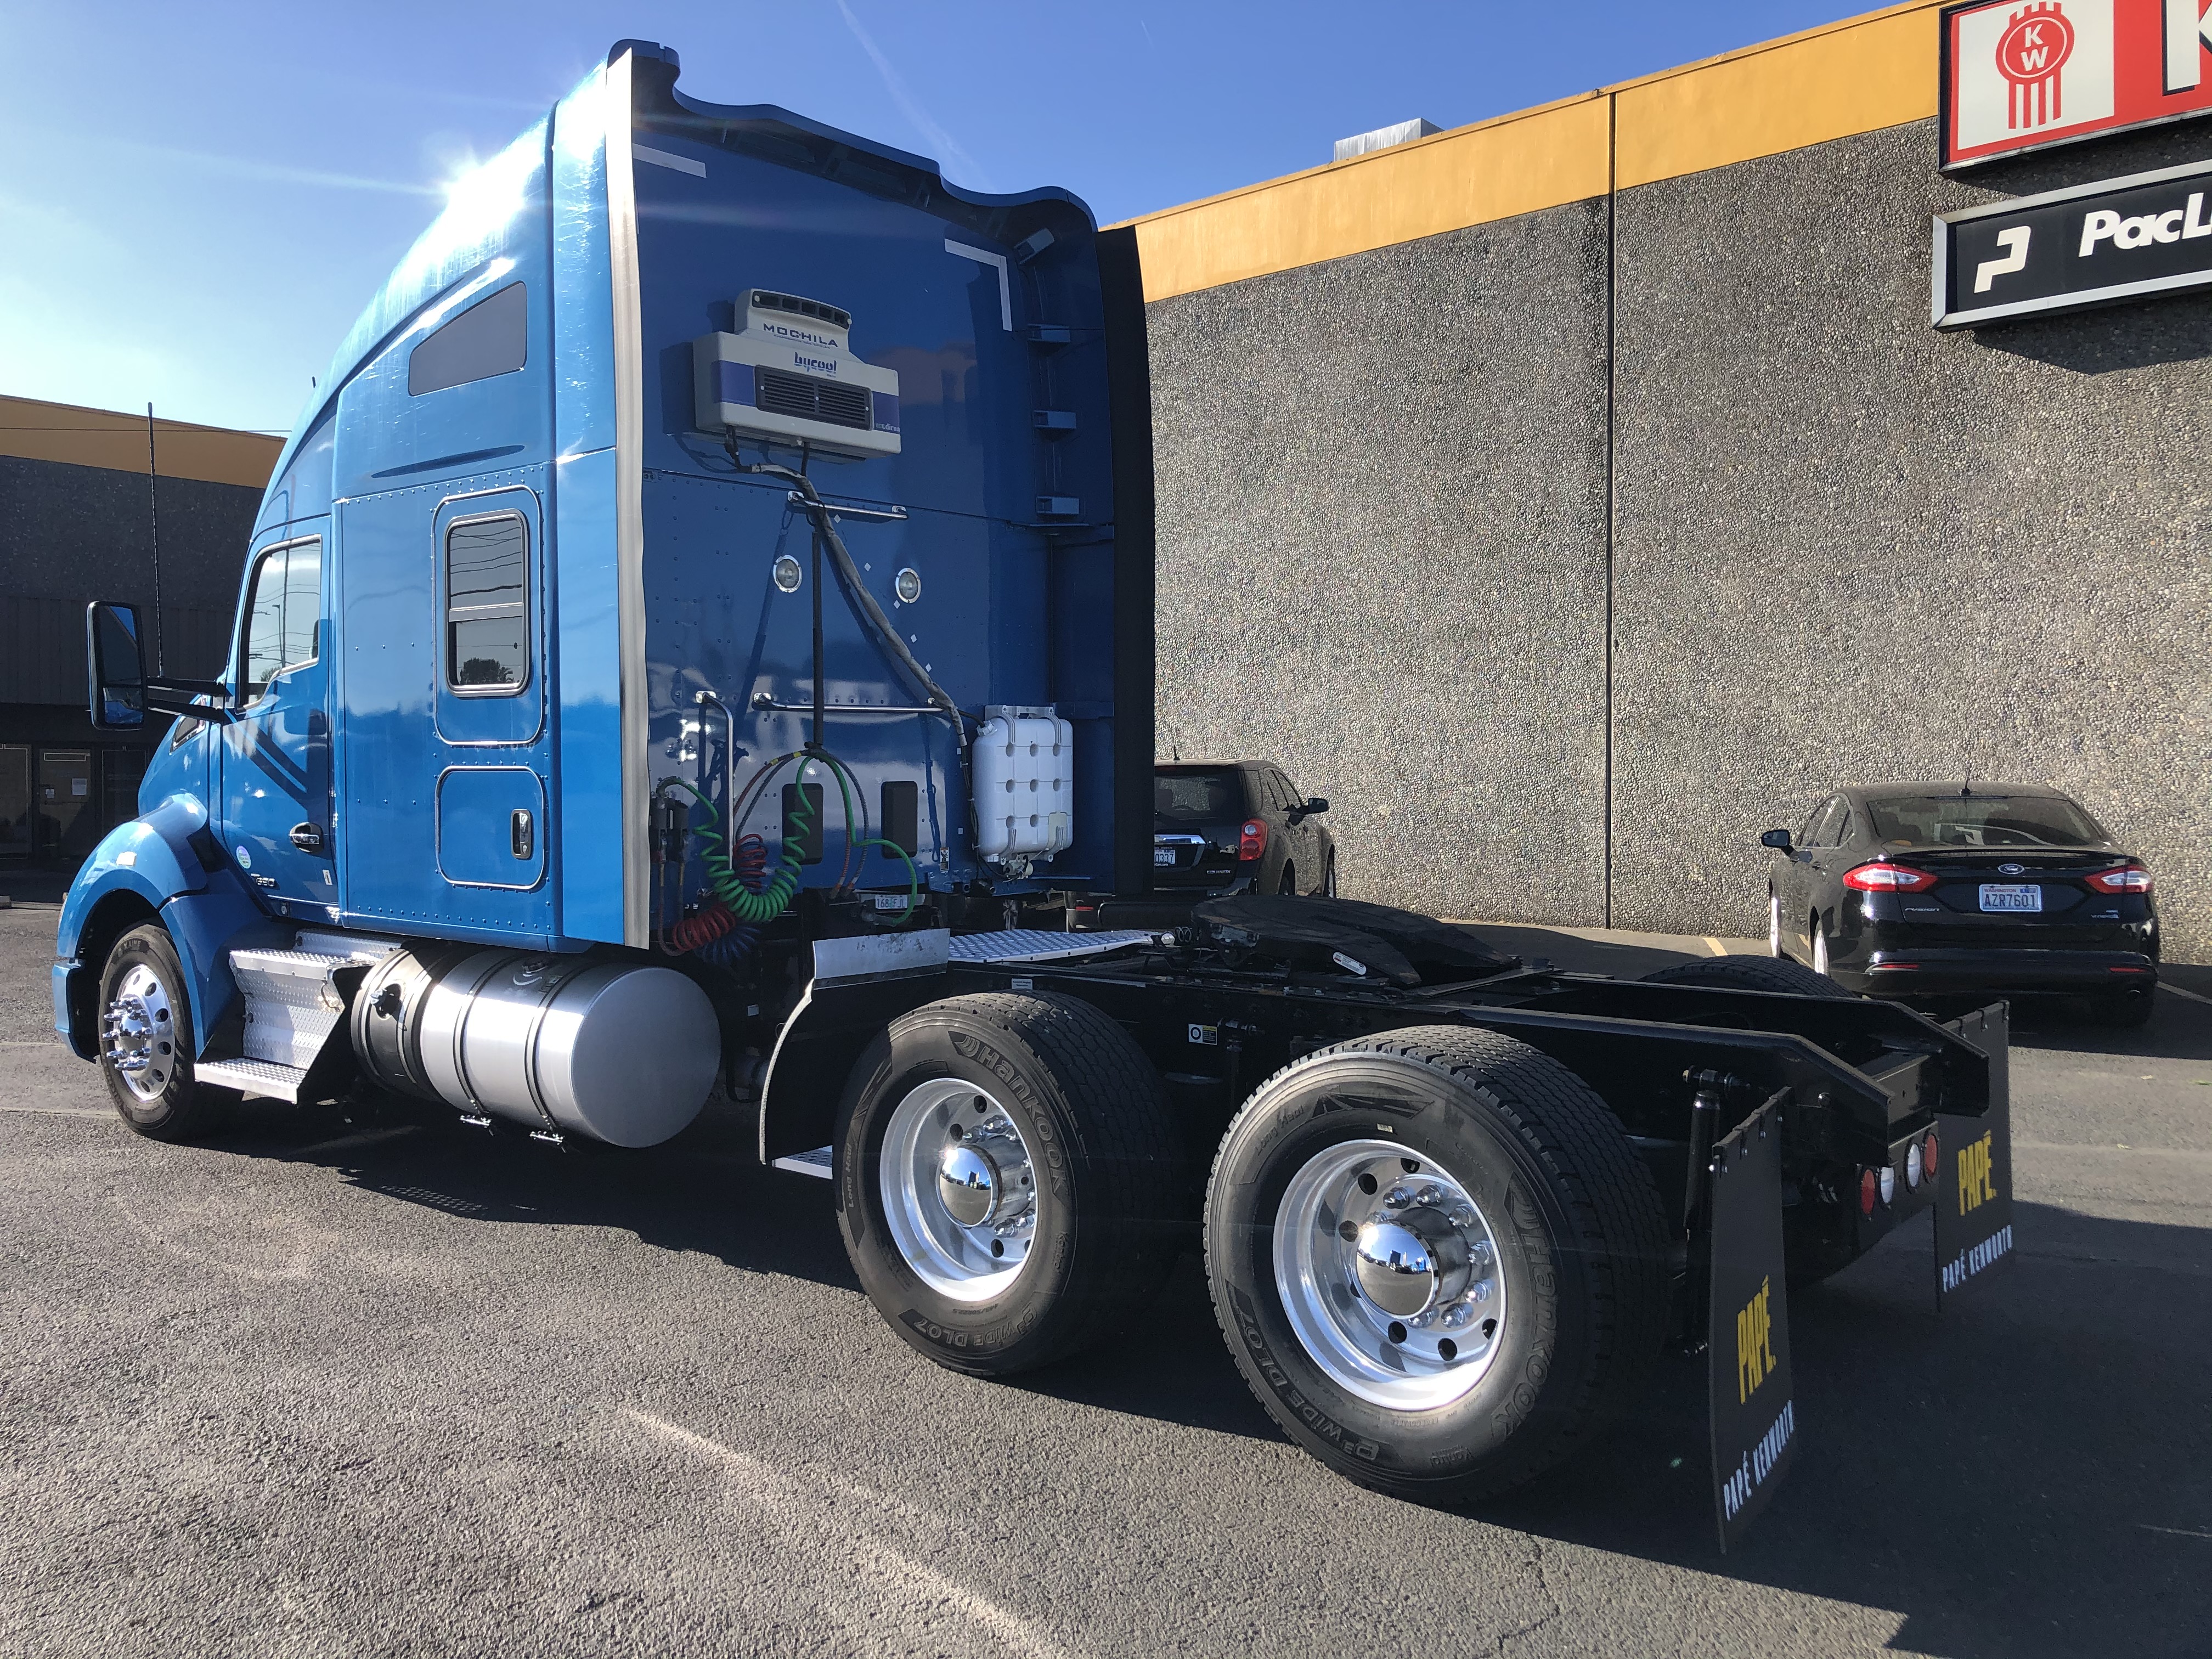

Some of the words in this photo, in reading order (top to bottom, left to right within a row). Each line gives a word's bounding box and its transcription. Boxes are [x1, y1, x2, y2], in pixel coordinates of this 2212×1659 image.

[2025, 24, 2044, 48] K
[2020, 47, 2048, 72] W
[2078, 193, 2212, 257] PacL
[763, 323, 839, 347] MOCHILA
[794, 351, 837, 374] bycool
[1984, 894, 2036, 907] AZR7601
